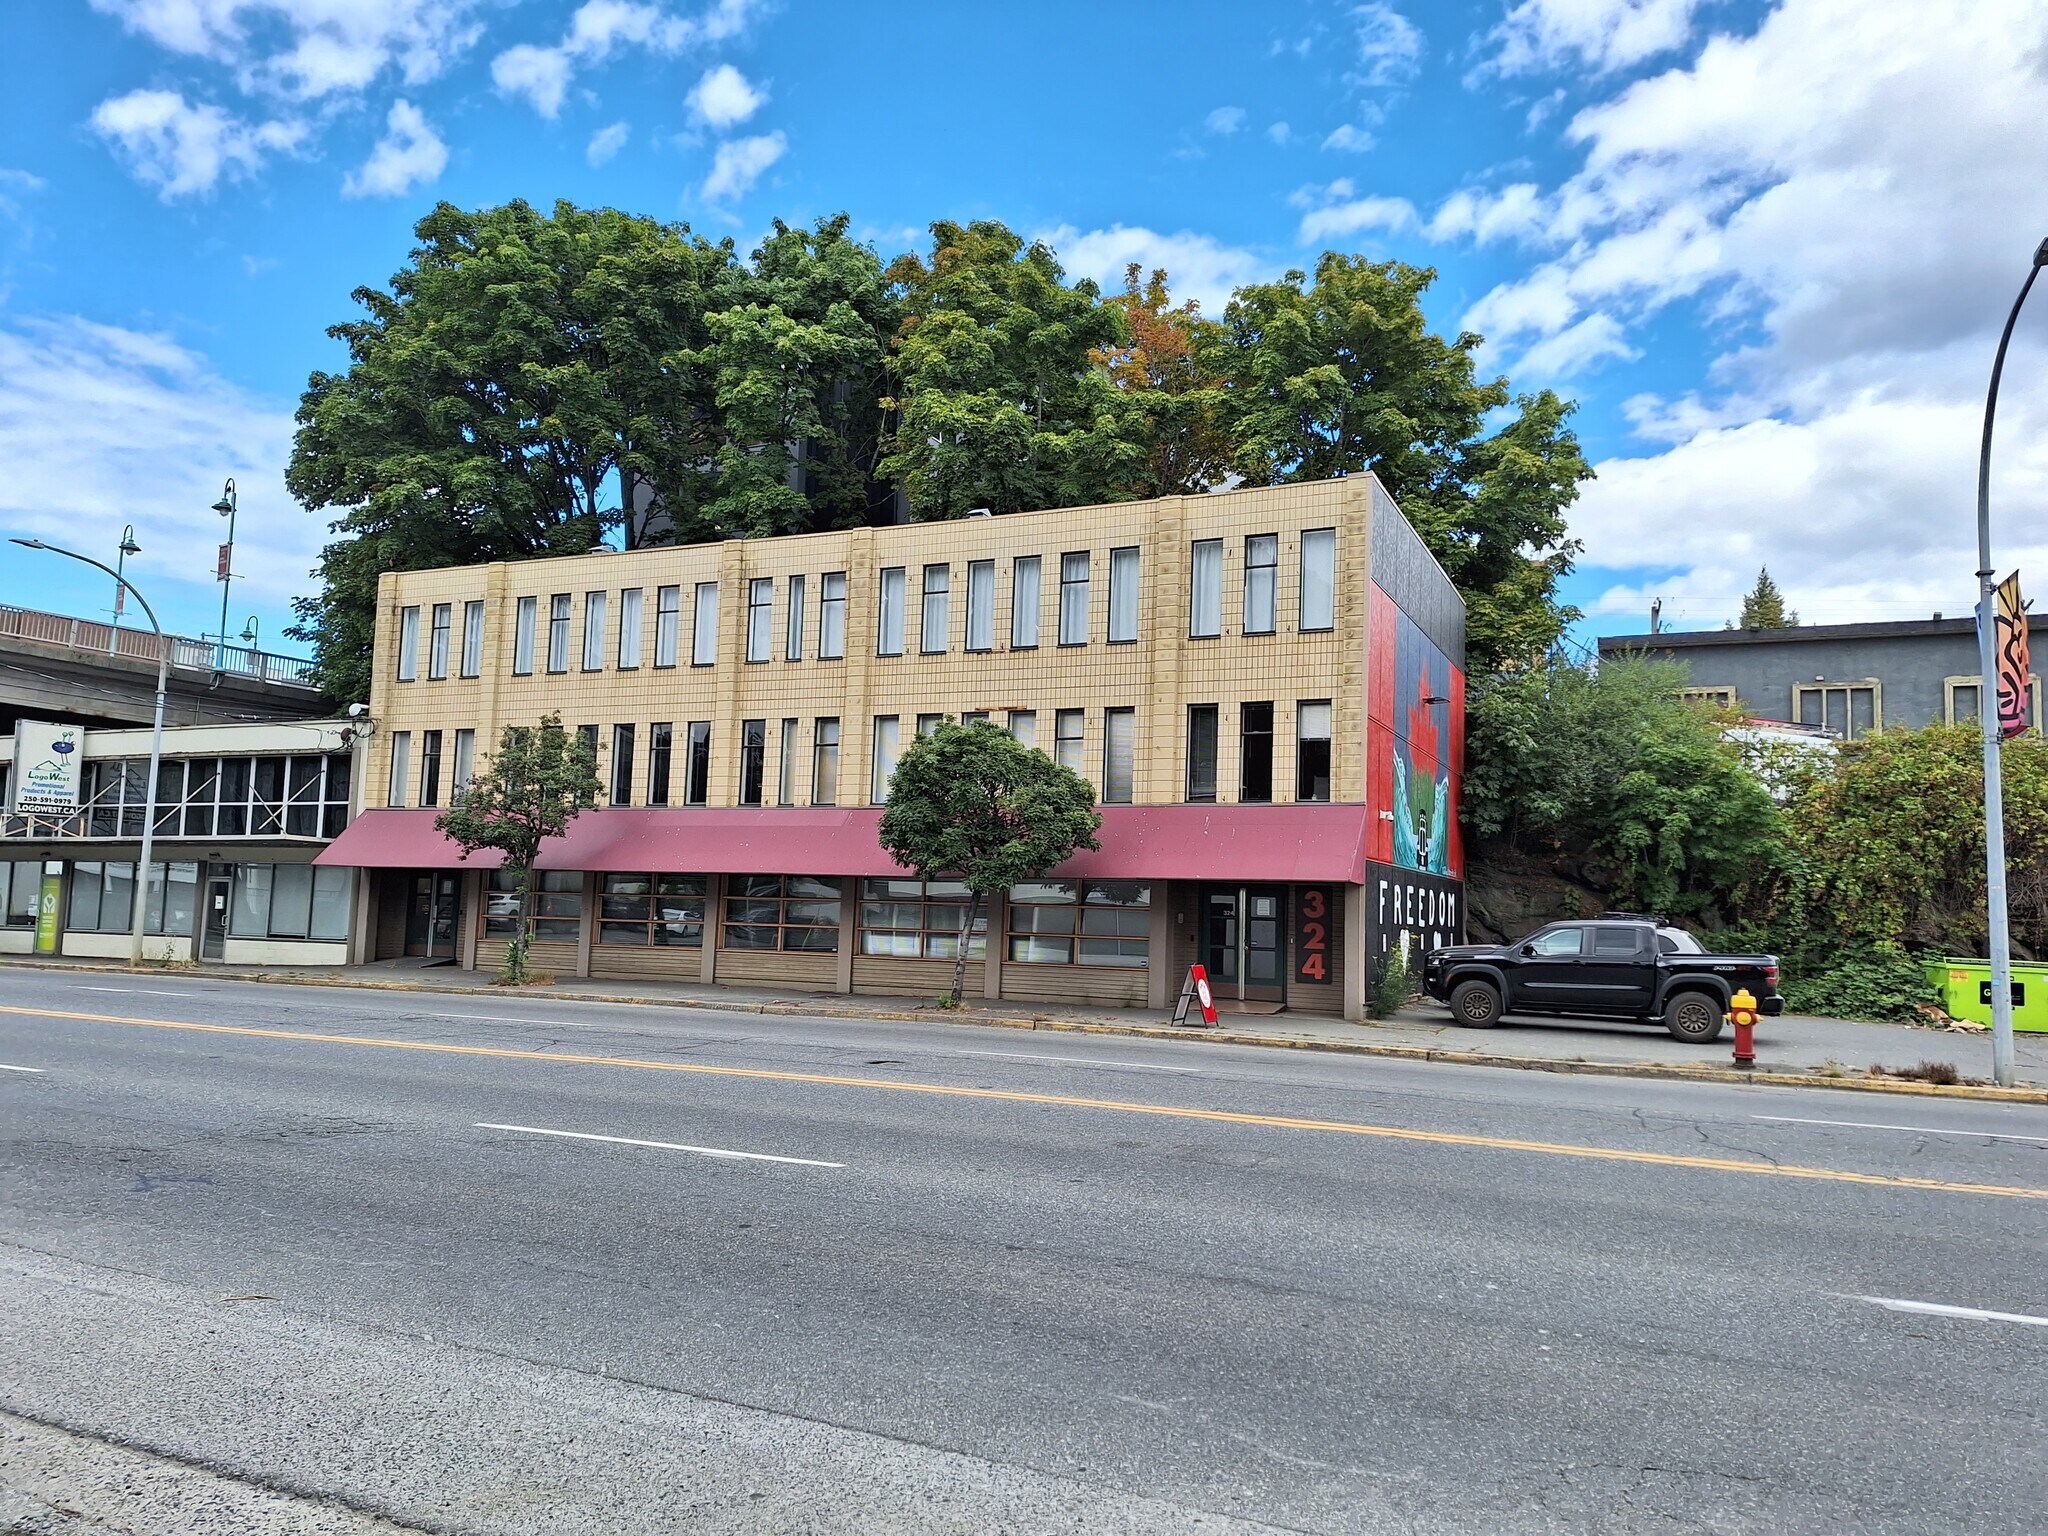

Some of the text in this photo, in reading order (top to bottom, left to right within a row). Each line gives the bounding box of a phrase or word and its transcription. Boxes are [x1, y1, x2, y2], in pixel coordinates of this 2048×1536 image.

[28, 771, 69, 781] LogoWest
[24, 796, 71, 804] 250-591-0979
[18, 804, 75, 814] LOGOWEST.CA
[1379, 879, 1455, 928] FREEDOM
